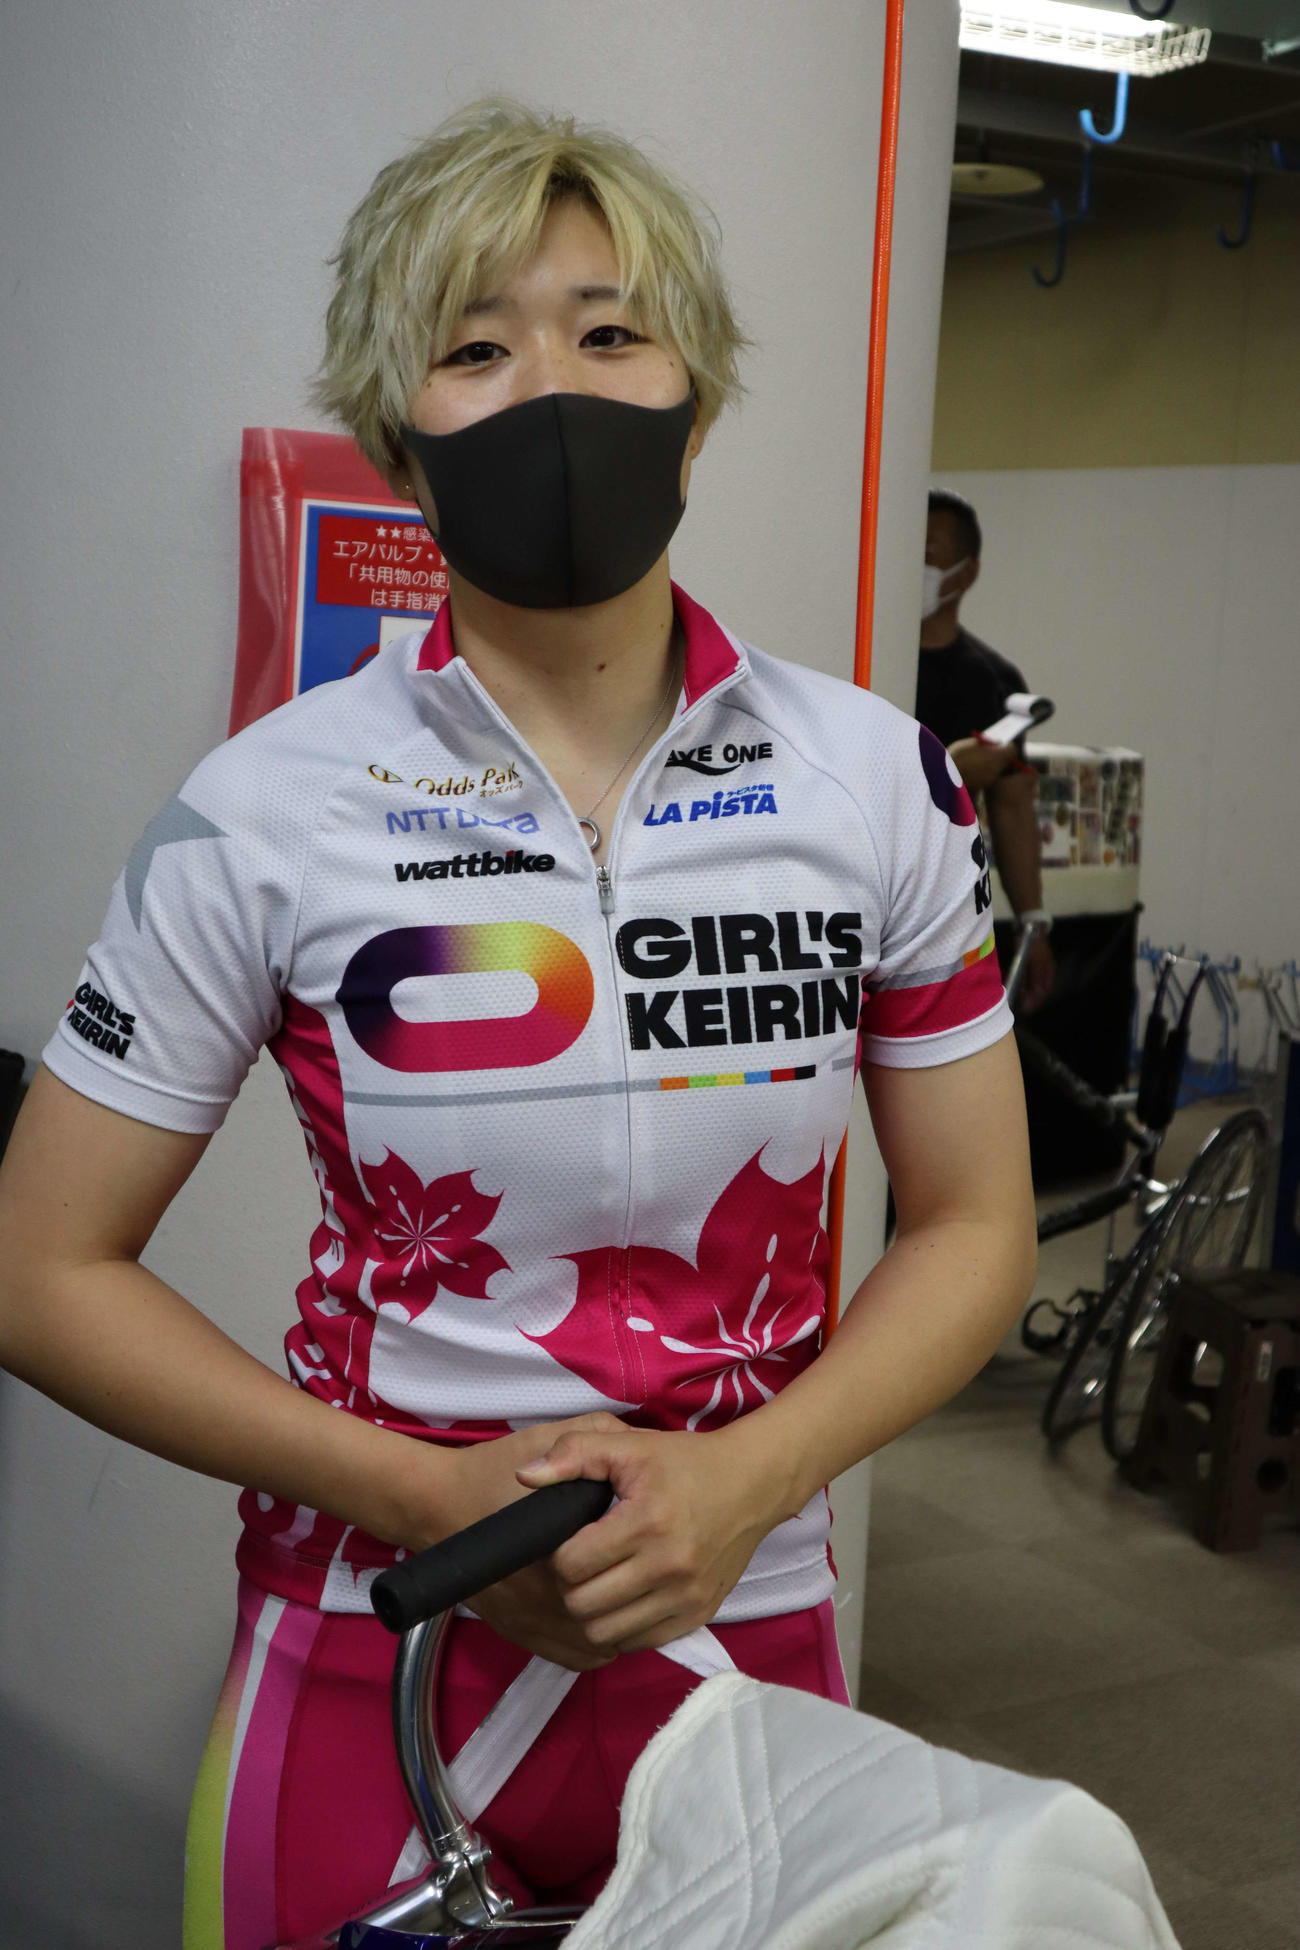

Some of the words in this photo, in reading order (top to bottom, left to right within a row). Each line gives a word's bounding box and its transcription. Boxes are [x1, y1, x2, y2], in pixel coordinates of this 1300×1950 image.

[403, 526, 434, 542] 感染
[349, 563, 450, 590] 「共用物の使
[371, 588, 448, 612] は手指消
[664, 744, 713, 767] AVE
[723, 742, 773, 763] ONE
[386, 807, 450, 835] NTT
[643, 803, 683, 827] LA
[394, 849, 556, 882] wattbike
[615, 911, 863, 980] GIRL'S
[75, 981, 136, 1036] GIRL'S
[624, 974, 860, 1051] KEIRIN
